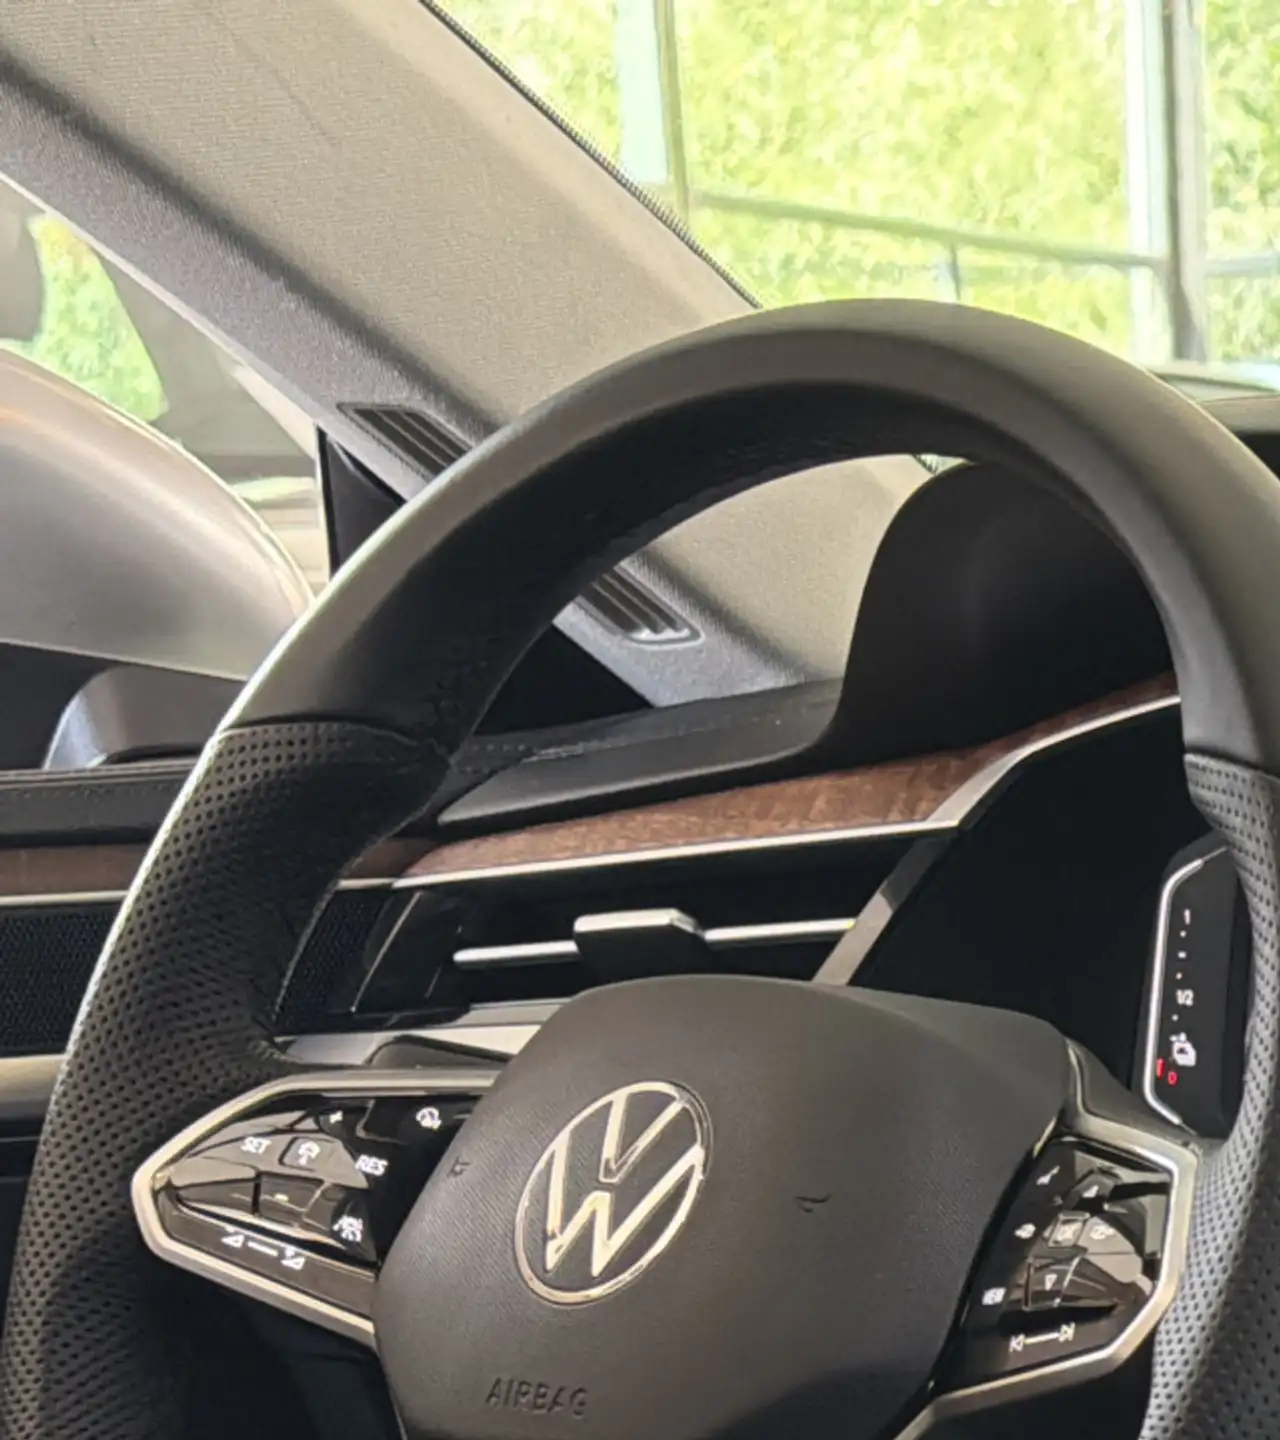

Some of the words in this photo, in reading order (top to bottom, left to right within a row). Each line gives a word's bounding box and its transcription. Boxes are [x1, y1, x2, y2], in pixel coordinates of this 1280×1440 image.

[240, 1136, 272, 1155] SET
[354, 1154, 389, 1177] RES
[485, 1377, 589, 1418] AIRBAG
